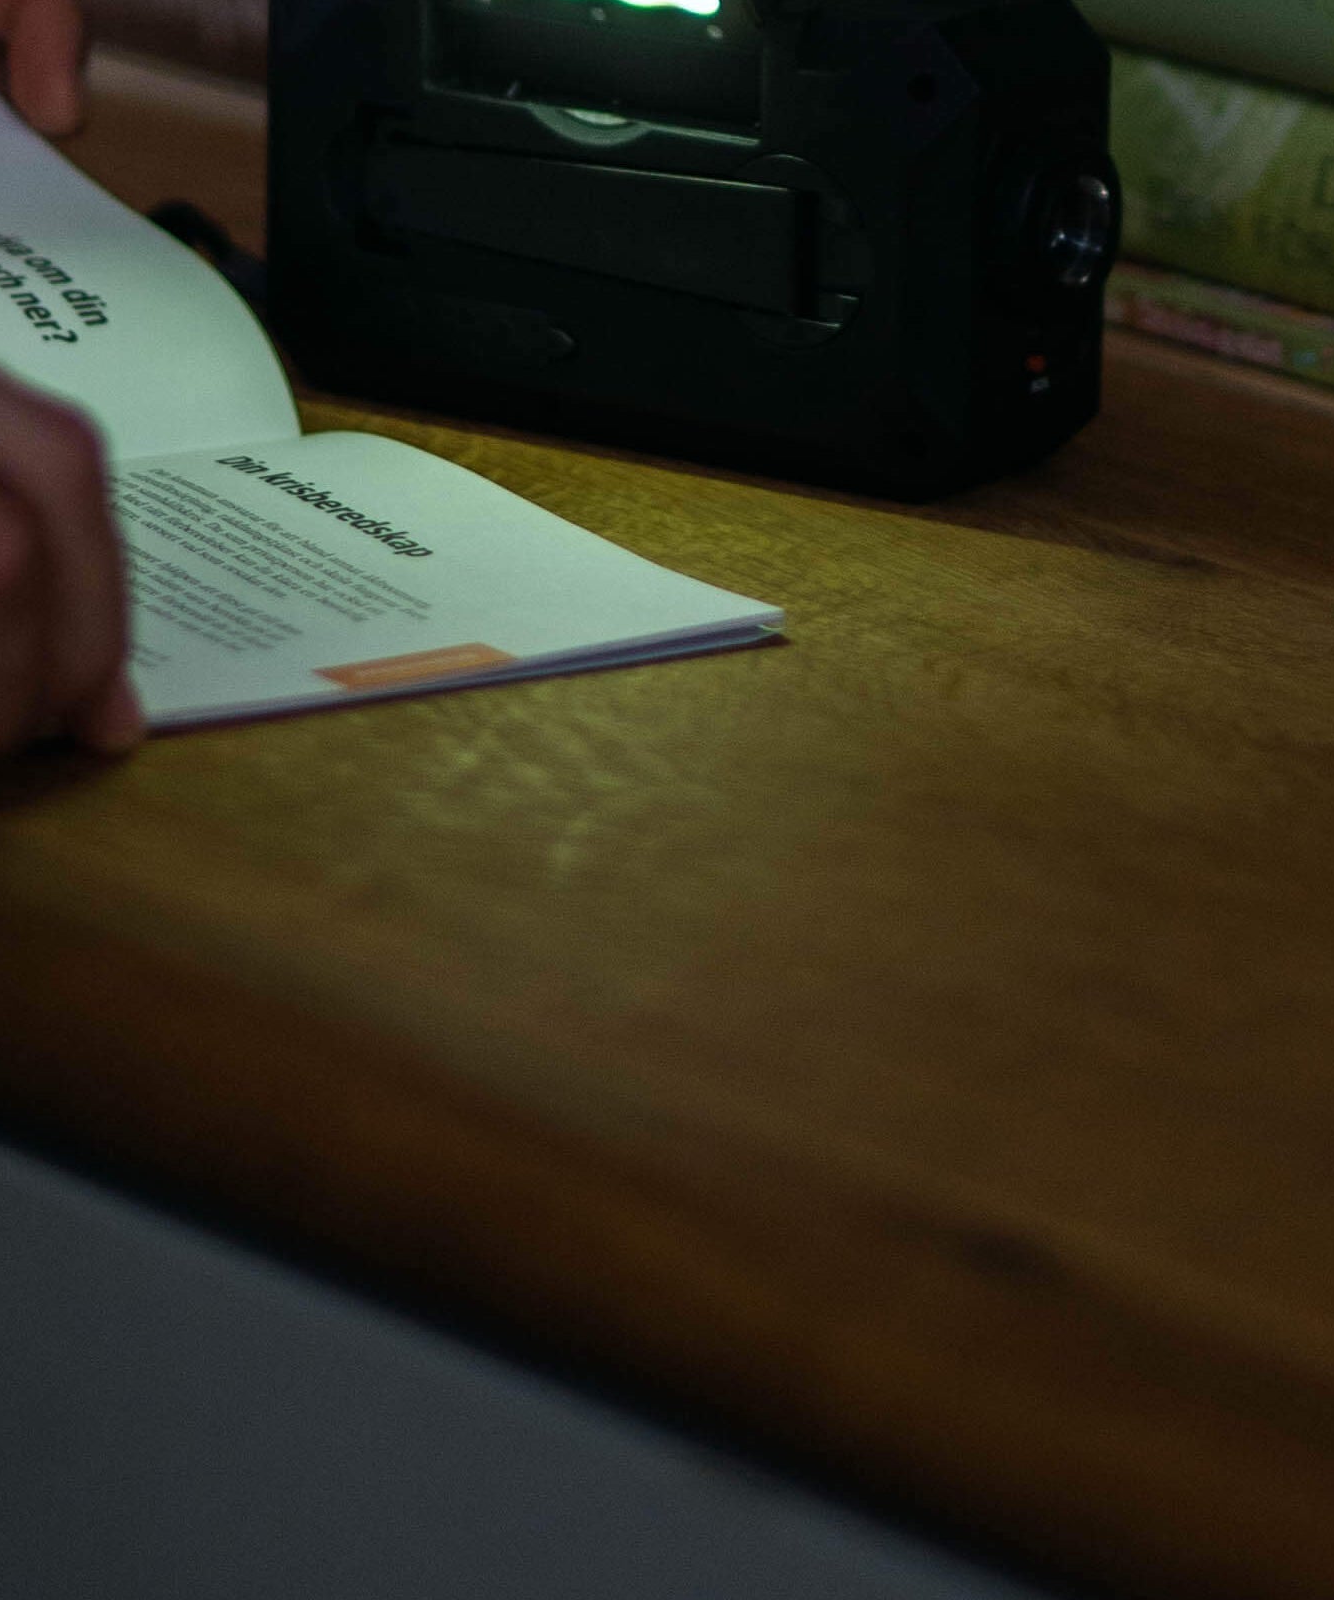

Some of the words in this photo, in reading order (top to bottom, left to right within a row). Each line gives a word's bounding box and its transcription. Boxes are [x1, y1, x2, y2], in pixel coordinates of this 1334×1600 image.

[9, 288, 79, 346] ner?
[24, 252, 72, 287] om
[61, 278, 110, 329] din
[216, 454, 270, 475] Din
[259, 471, 435, 560] krisberedskap
